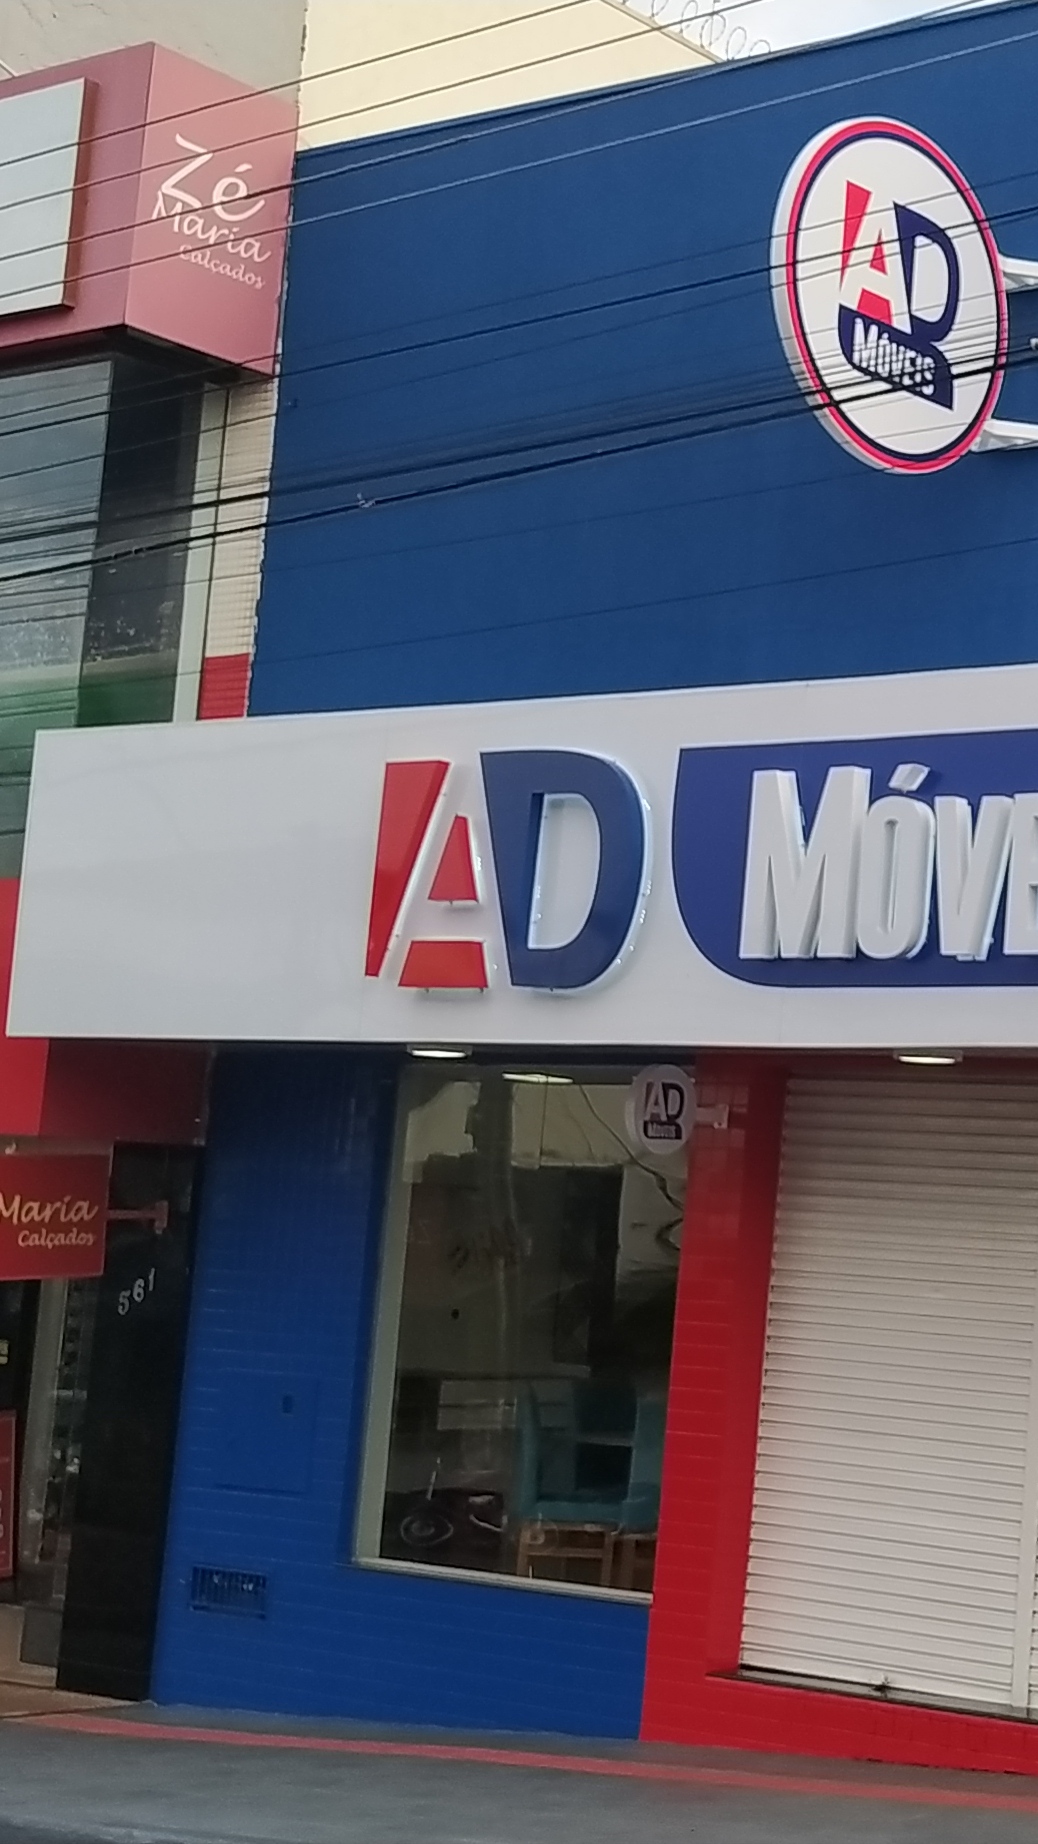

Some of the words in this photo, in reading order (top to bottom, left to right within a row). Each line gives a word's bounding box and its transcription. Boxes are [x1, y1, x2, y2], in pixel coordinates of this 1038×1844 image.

[161, 133, 266, 222] Zé
[152, 190, 272, 262] Maria
[179, 244, 266, 289] Calçados
[838, 179, 961, 341] AD
[364, 747, 652, 993] AD
[644, 1081, 685, 1122] AD
[0, 1192, 98, 1226] Maria
[18, 1227, 96, 1249] Calçados
[117, 1267, 156, 1316] 561
